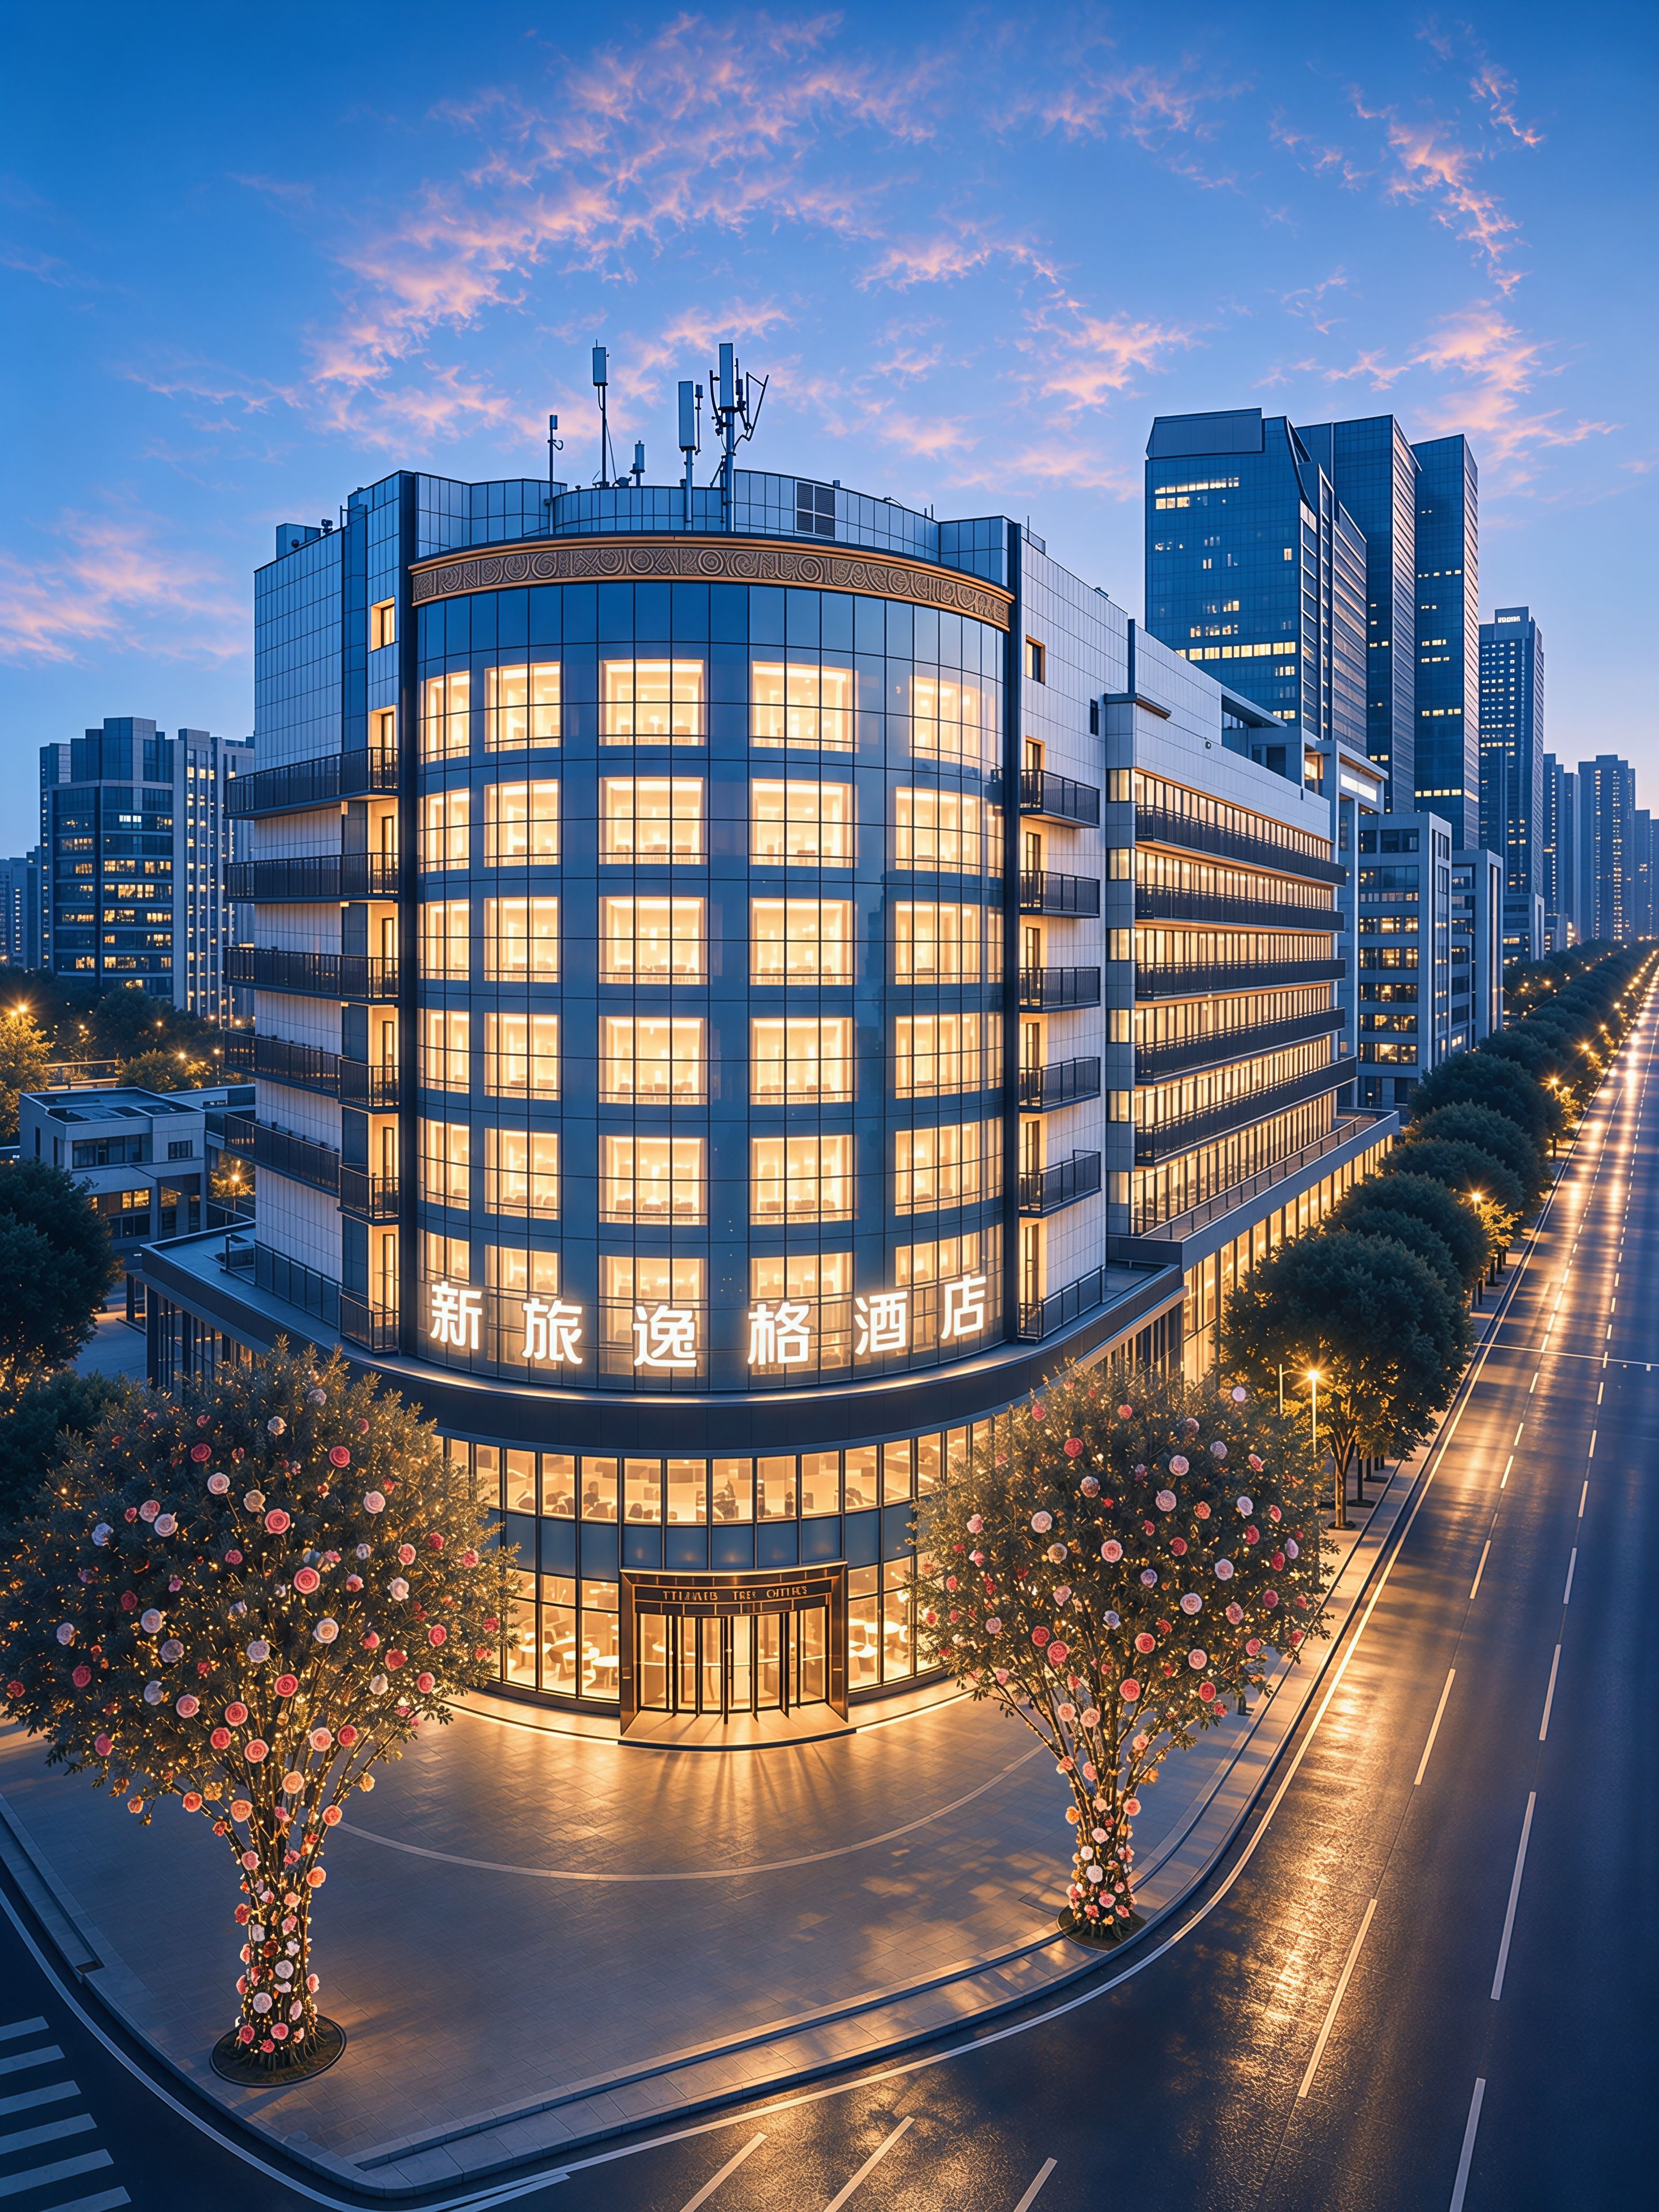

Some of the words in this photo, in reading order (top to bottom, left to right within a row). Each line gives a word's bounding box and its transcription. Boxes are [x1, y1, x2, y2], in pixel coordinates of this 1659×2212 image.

[430, 1274, 987, 1367] 新旅逸格酒店
